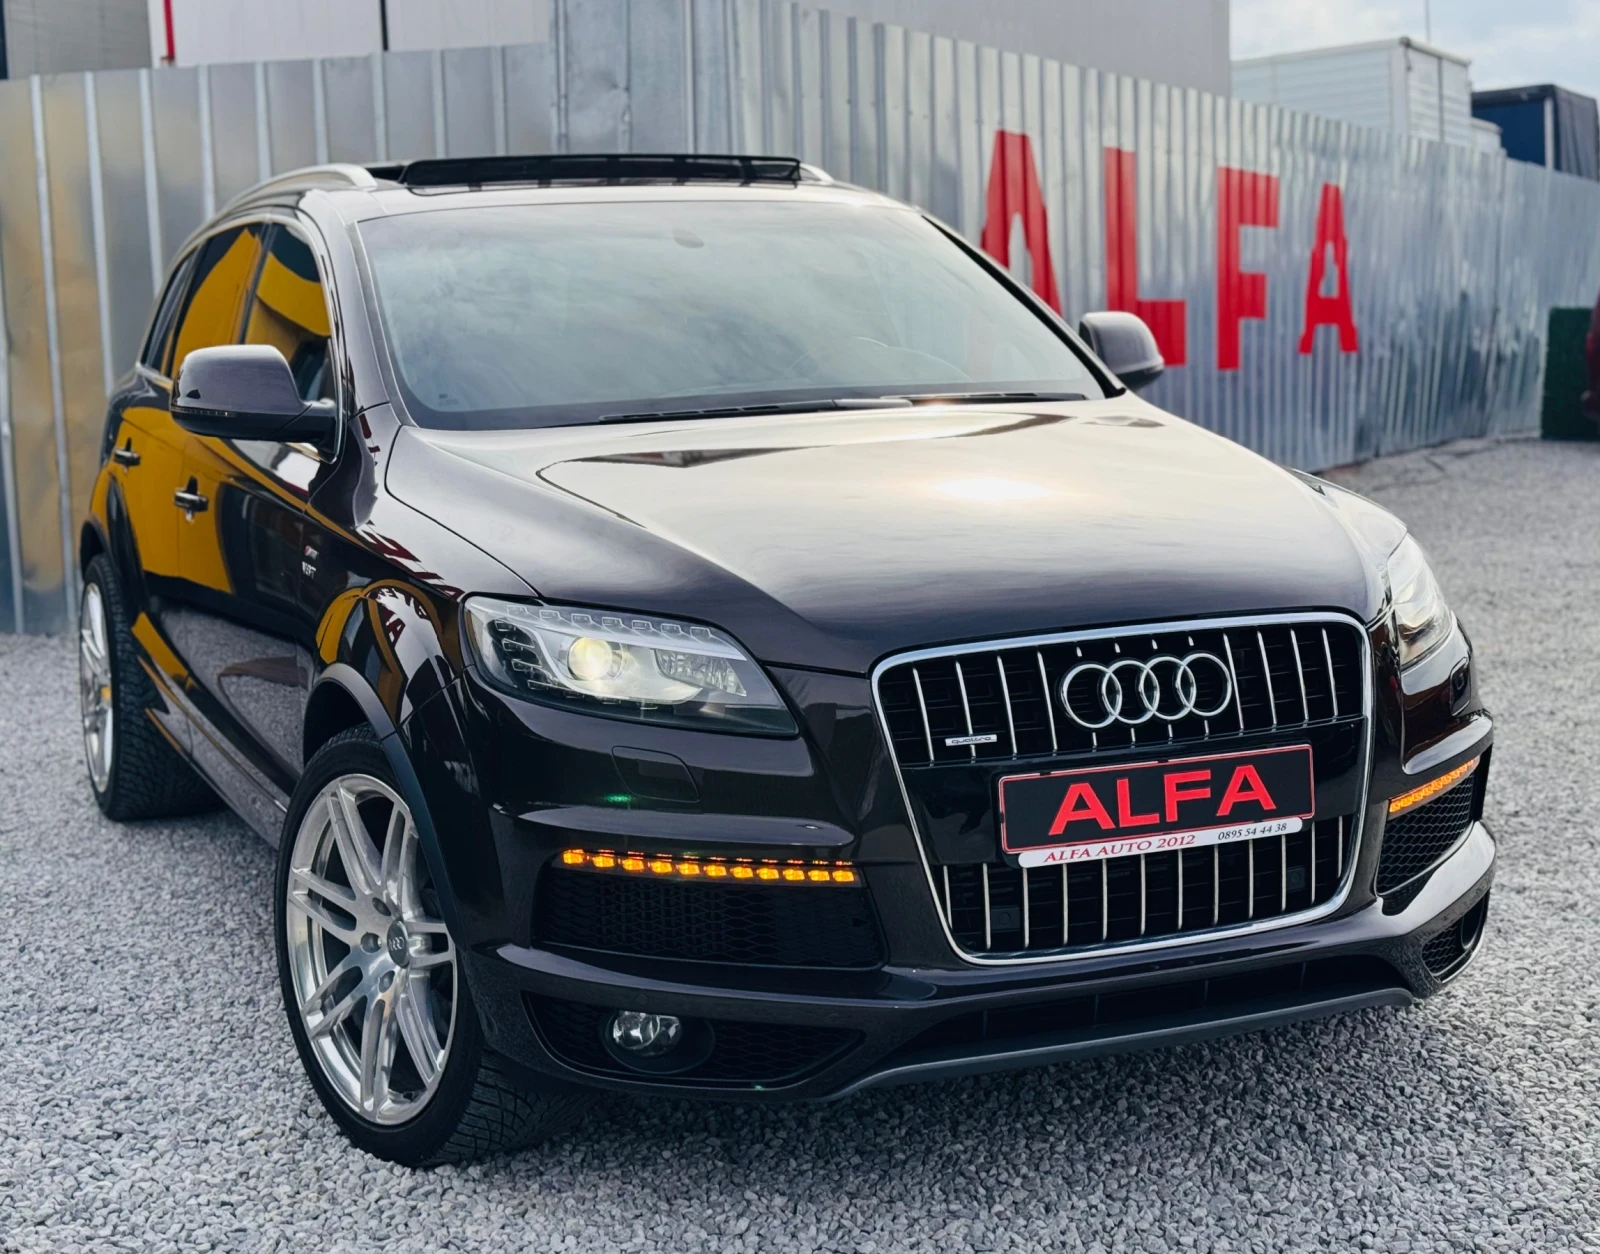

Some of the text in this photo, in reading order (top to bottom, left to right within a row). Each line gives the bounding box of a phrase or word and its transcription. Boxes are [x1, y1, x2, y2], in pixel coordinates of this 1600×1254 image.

[981, 130, 1358, 371] ALFA
[951, 736, 992, 744] quattro
[1048, 764, 1277, 836] ALFA
[1218, 822, 1288, 841] 0895 54 44 38
[1044, 834, 1196, 863] ALFA AUTO 2012
